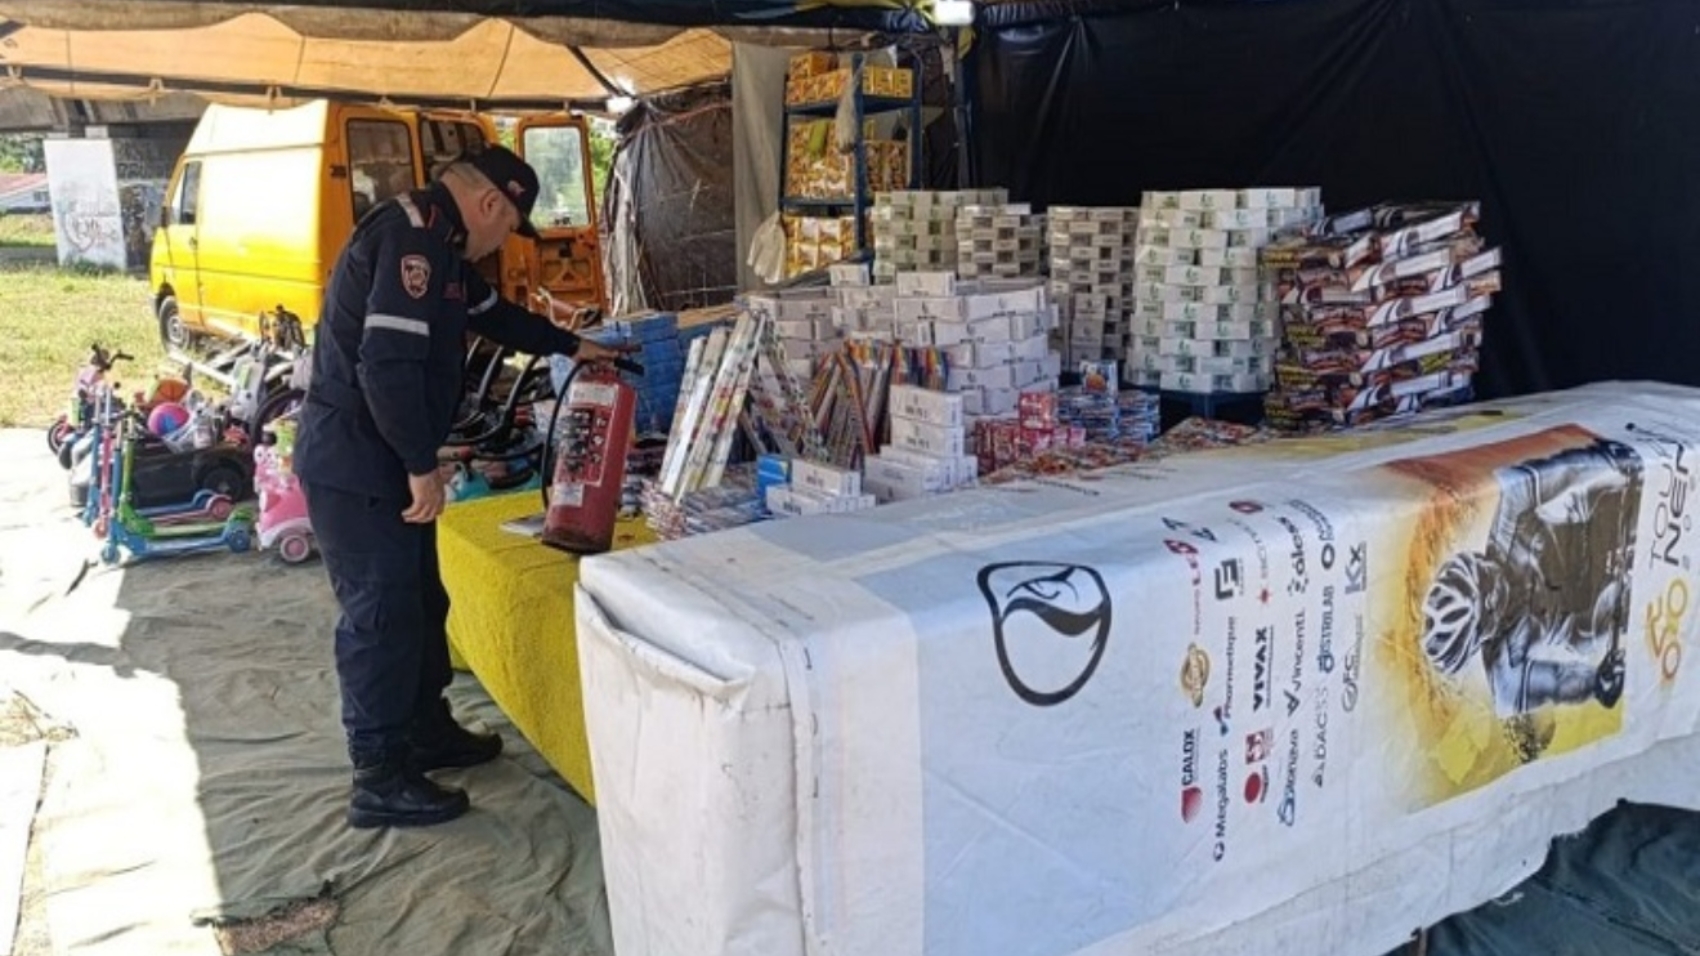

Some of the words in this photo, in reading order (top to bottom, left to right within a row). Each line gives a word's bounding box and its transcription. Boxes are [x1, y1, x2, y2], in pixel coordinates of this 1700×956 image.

[1253, 627, 1267, 712] VIVAX
[1181, 728, 1195, 786] CALOX
[1215, 749, 1229, 838] Megalabs
